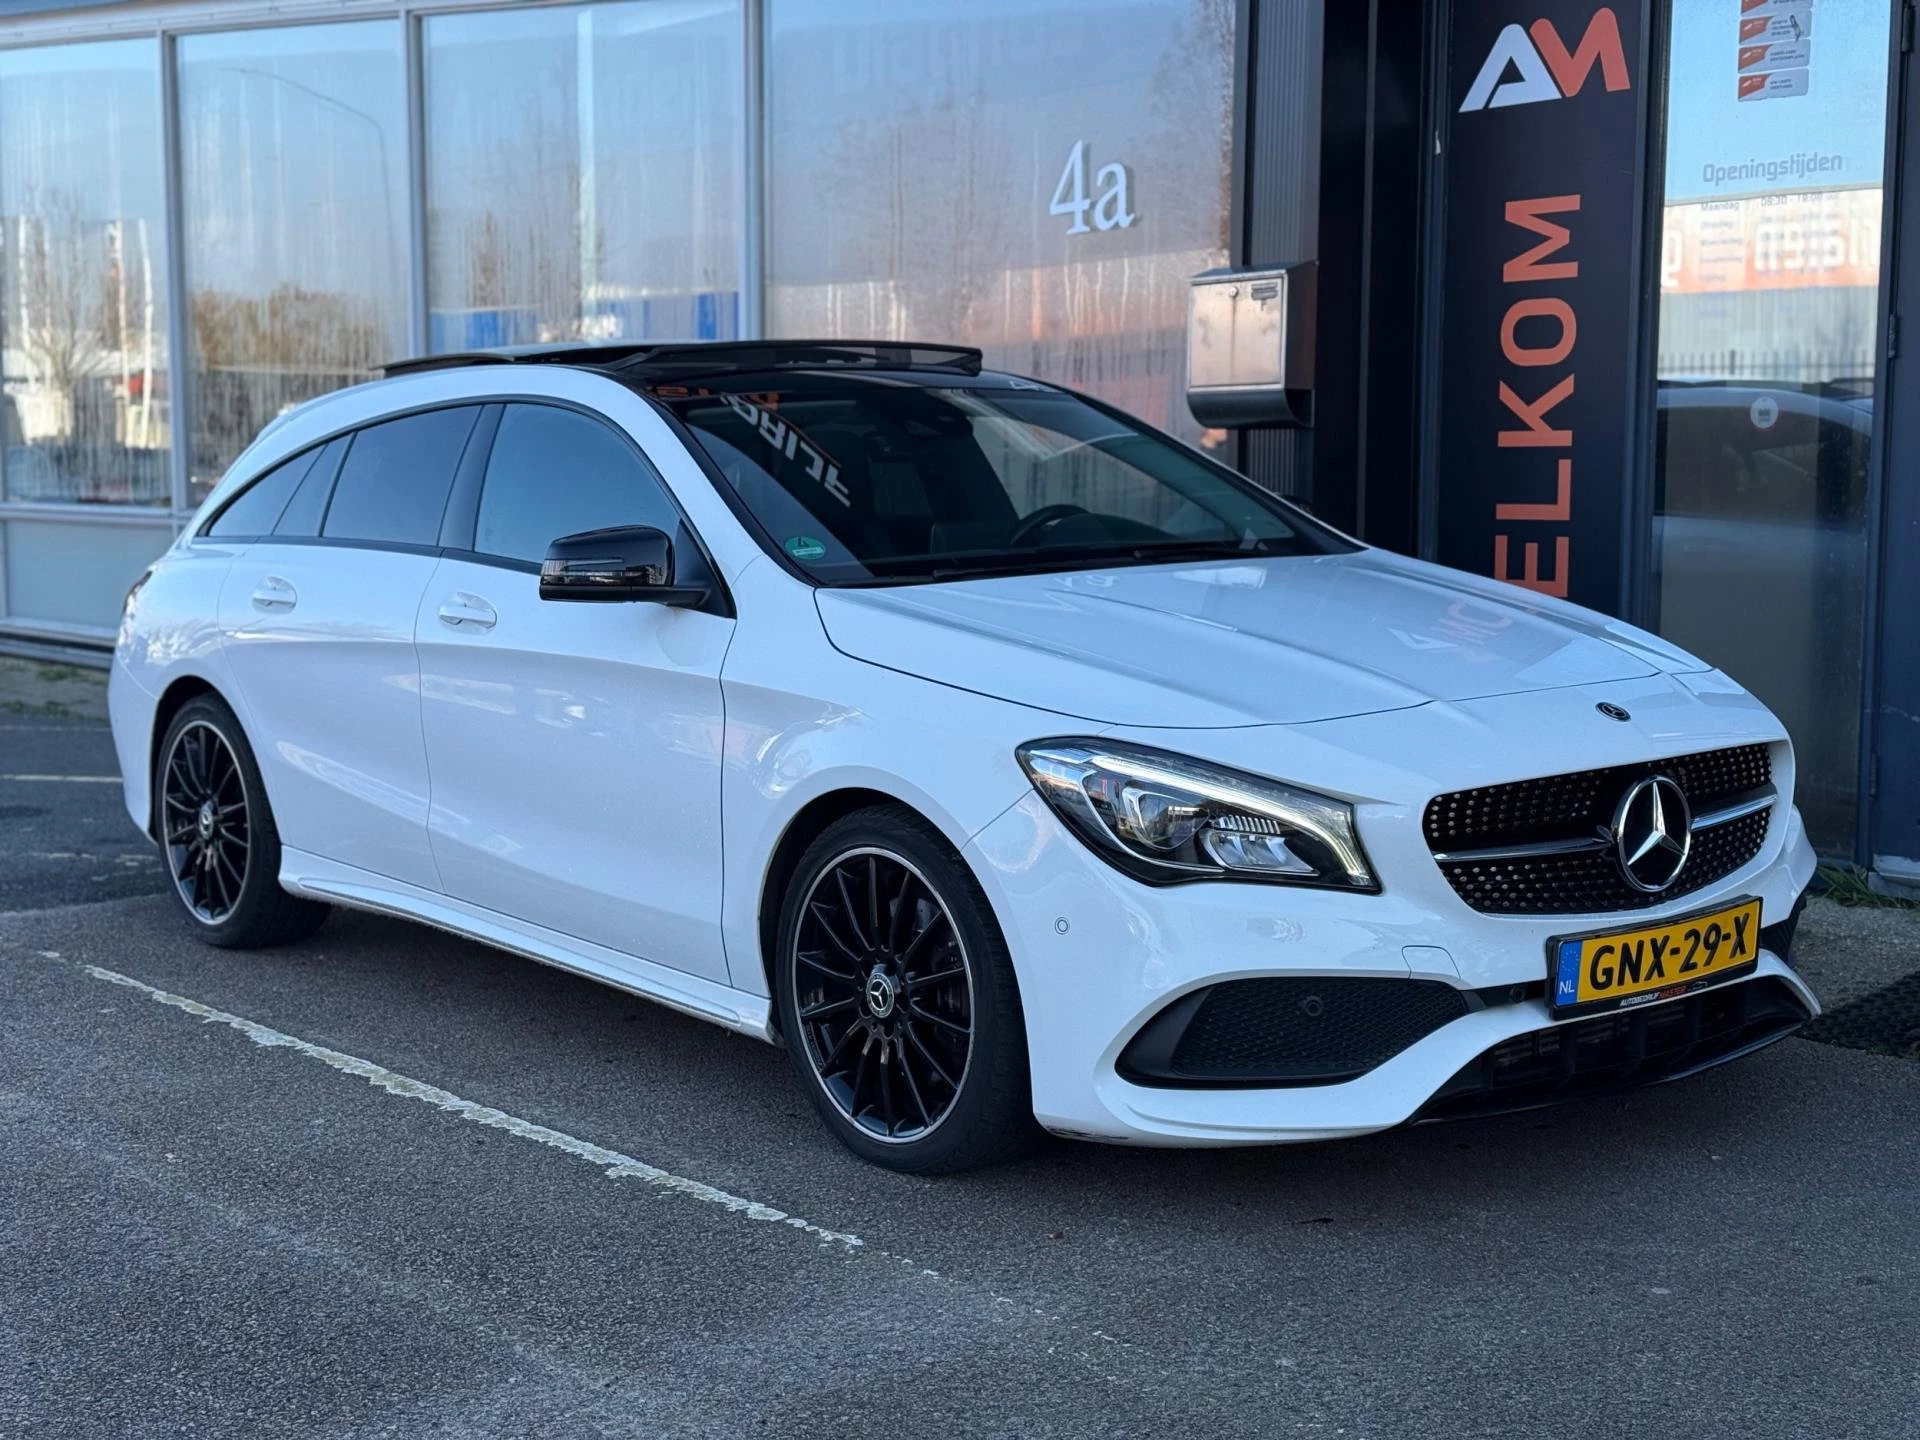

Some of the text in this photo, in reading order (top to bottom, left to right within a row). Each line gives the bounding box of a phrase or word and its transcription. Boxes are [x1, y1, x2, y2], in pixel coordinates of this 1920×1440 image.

[1049, 140, 1136, 235] 4a
[1702, 151, 1844, 187] Openingstijden
[1589, 912, 1751, 992] GNX-29-X
[1558, 979, 1576, 995] NL
